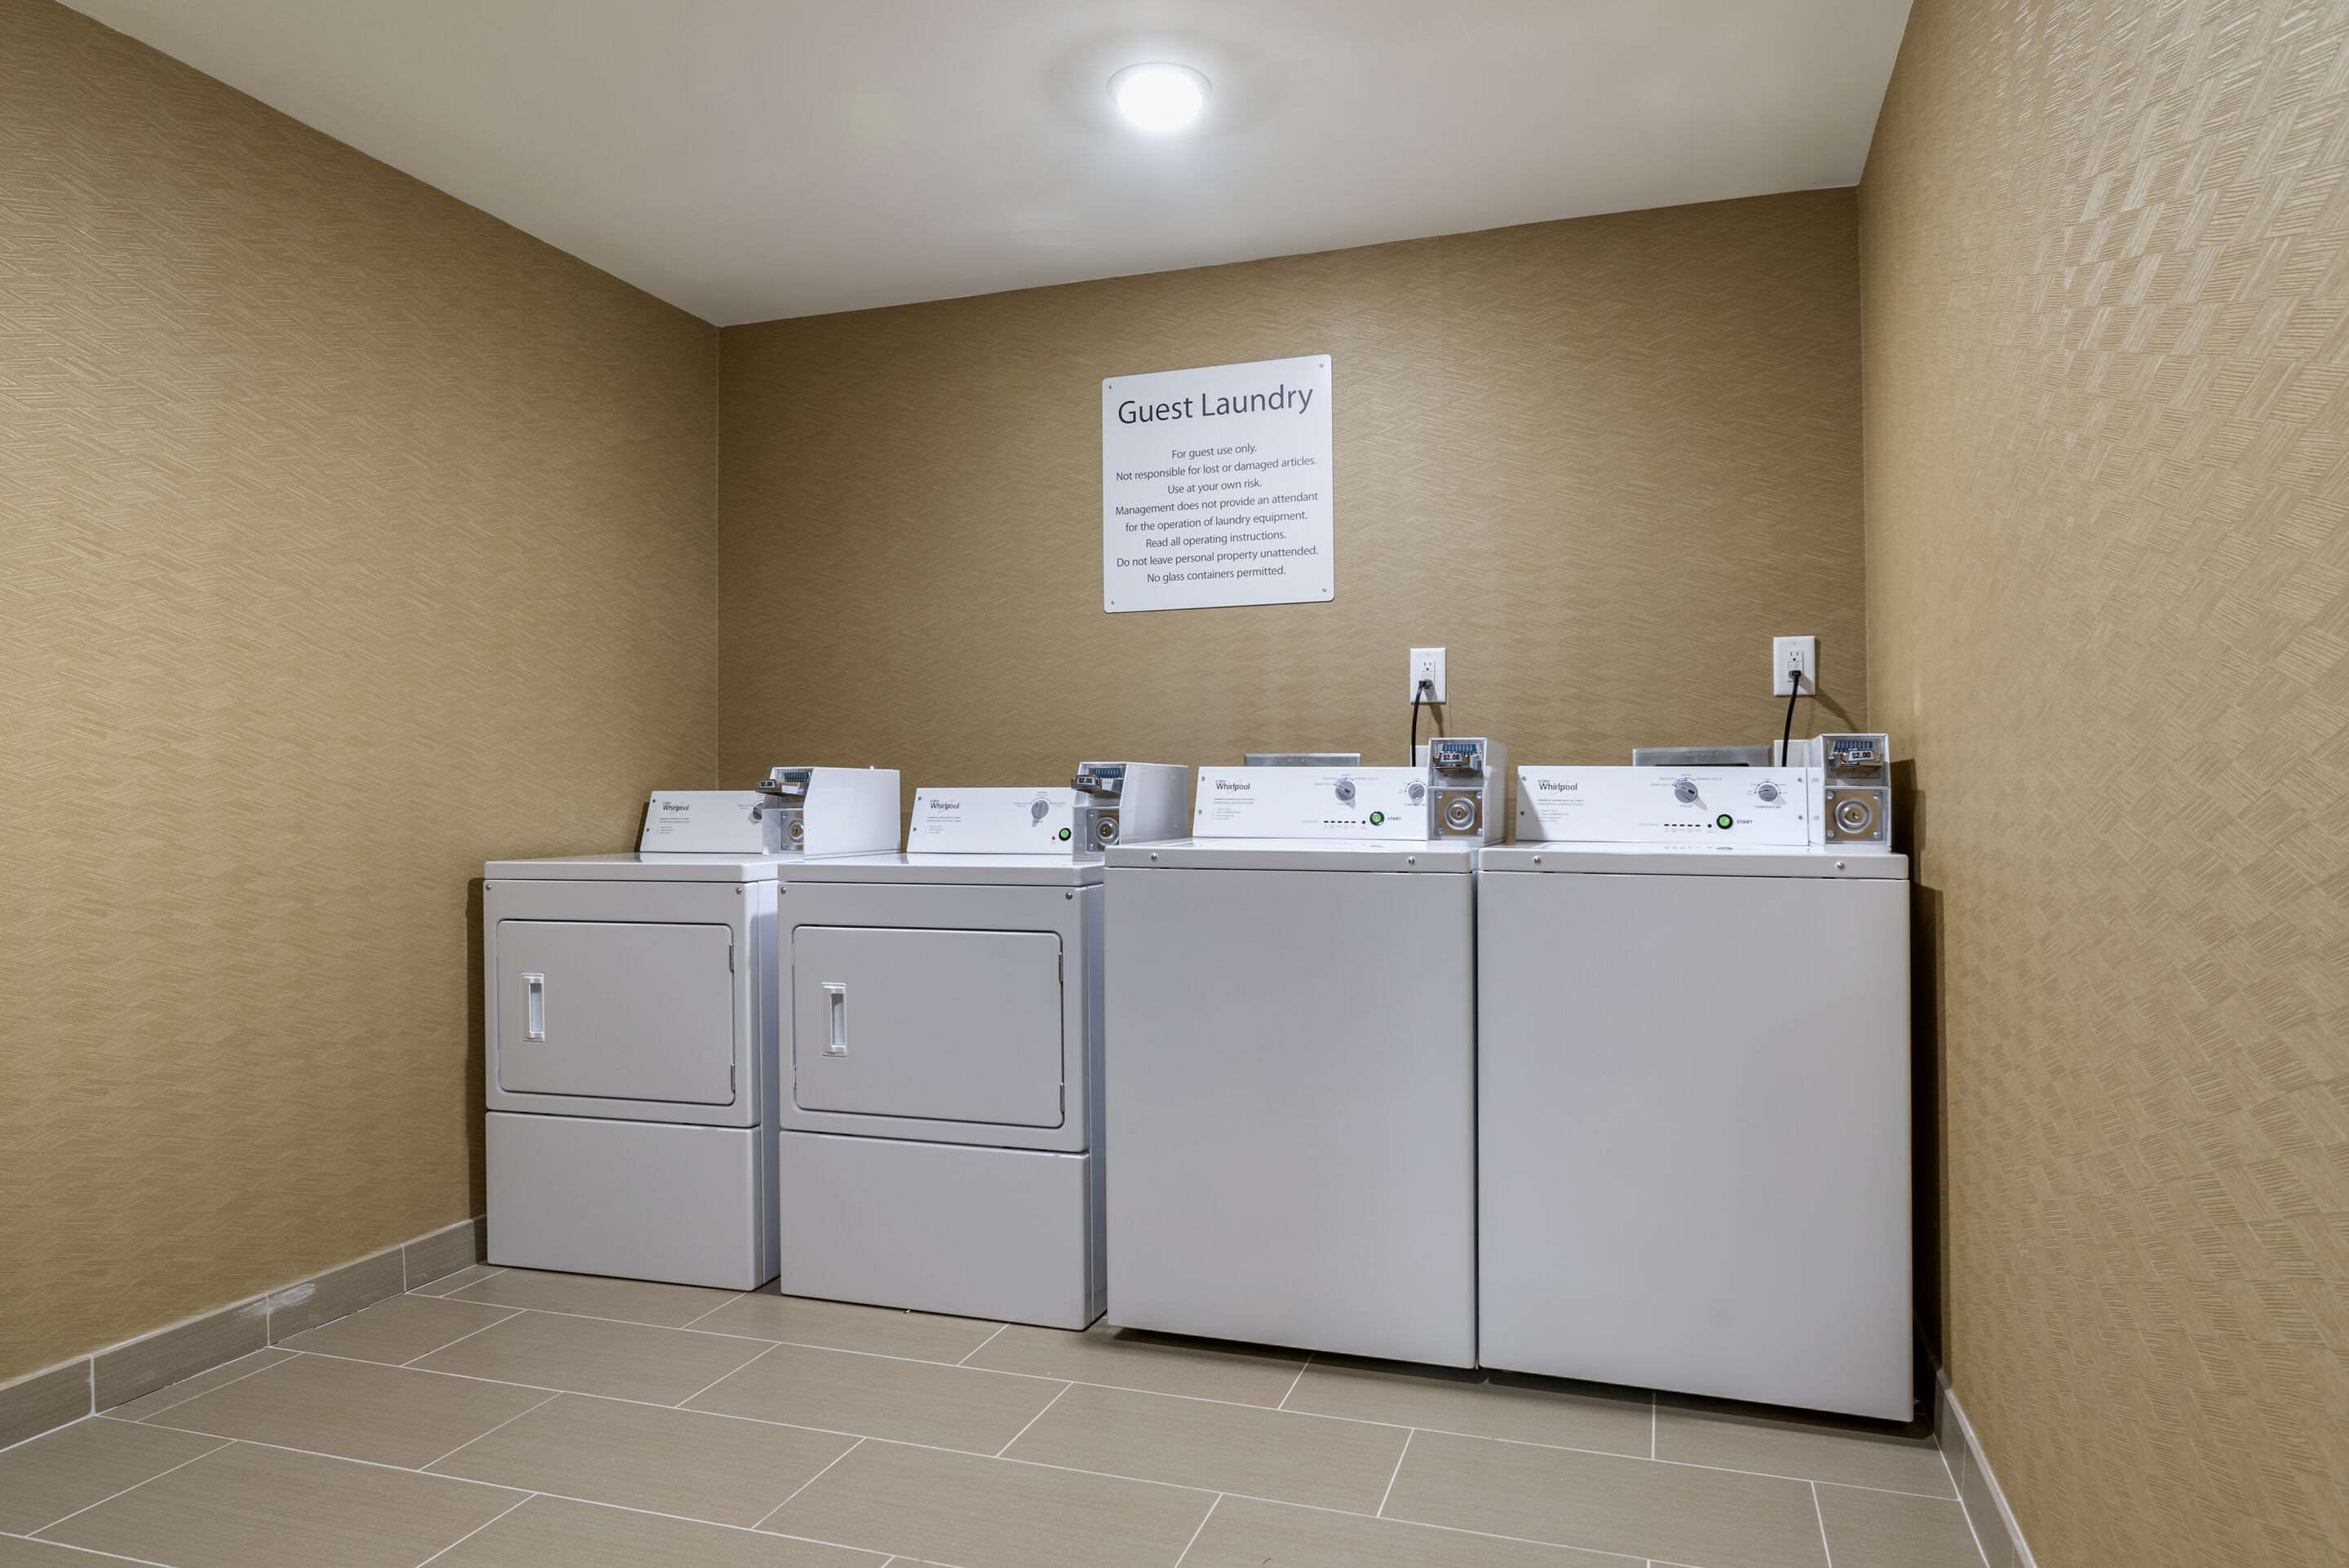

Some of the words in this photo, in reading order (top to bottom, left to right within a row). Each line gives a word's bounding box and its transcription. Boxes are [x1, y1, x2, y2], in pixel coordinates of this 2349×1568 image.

[1117, 397, 1193, 424] Guest
[1201, 383, 1313, 417] Laundry
[1171, 449, 1188, 459] For
[1188, 447, 1214, 460] guest
[1216, 447, 1233, 455] use
[1234, 443, 1257, 455] only.
[1116, 471, 1134, 483] Not
[1135, 466, 1186, 482] responsible
[1188, 465, 1201, 475] for
[1202, 464, 1219, 474] lost
[1221, 464, 1232, 472] or
[1233, 457, 1279, 471] damaged
[1281, 456, 1316, 467] articles.
[1167, 484, 1185, 494] Use
[1186, 483, 1197, 493] at
[1197, 483, 1219, 494] your
[1220, 481, 1241, 490] own
[1243, 477, 1263, 488] risk.
[1115, 503, 1175, 516] Management
[1176, 501, 1200, 511] does
[1201, 500, 1217, 509] not
[1219, 496, 1255, 510] provide
[1257, 497, 1269, 505] an
[1272, 492, 1318, 504] attendant
[1126, 522, 1139, 534] for
[1139, 521, 1157, 532] the
[1157, 518, 1201, 532] operation
[1203, 515, 1214, 527] of
[1215, 514, 1251, 526] laundry
[1253, 511, 1308, 525] equipment.
[1145, 537, 1168, 548] Read
[1170, 536, 1181, 548] all
[1183, 534, 1228, 547] operating
[1230, 530, 1286, 542] instructions.
[1117, 558, 1130, 568] Do
[1132, 557, 1148, 567] not
[1149, 554, 1173, 565] leave
[1174, 551, 1214, 567] personal
[1217, 550, 1258, 563] property
[1260, 545, 1318, 559] unattended.
[1147, 573, 1161, 583] No
[1162, 571, 1185, 584] glass
[1186, 569, 1234, 581] containers
[1236, 564, 1285, 580] permitted.
[1215, 782, 1250, 792] Whirlpool
[1538, 782, 1578, 793] Whirlpool
[662, 804, 690, 812] Whirlpool
[930, 802, 960, 811] Whirlpool
